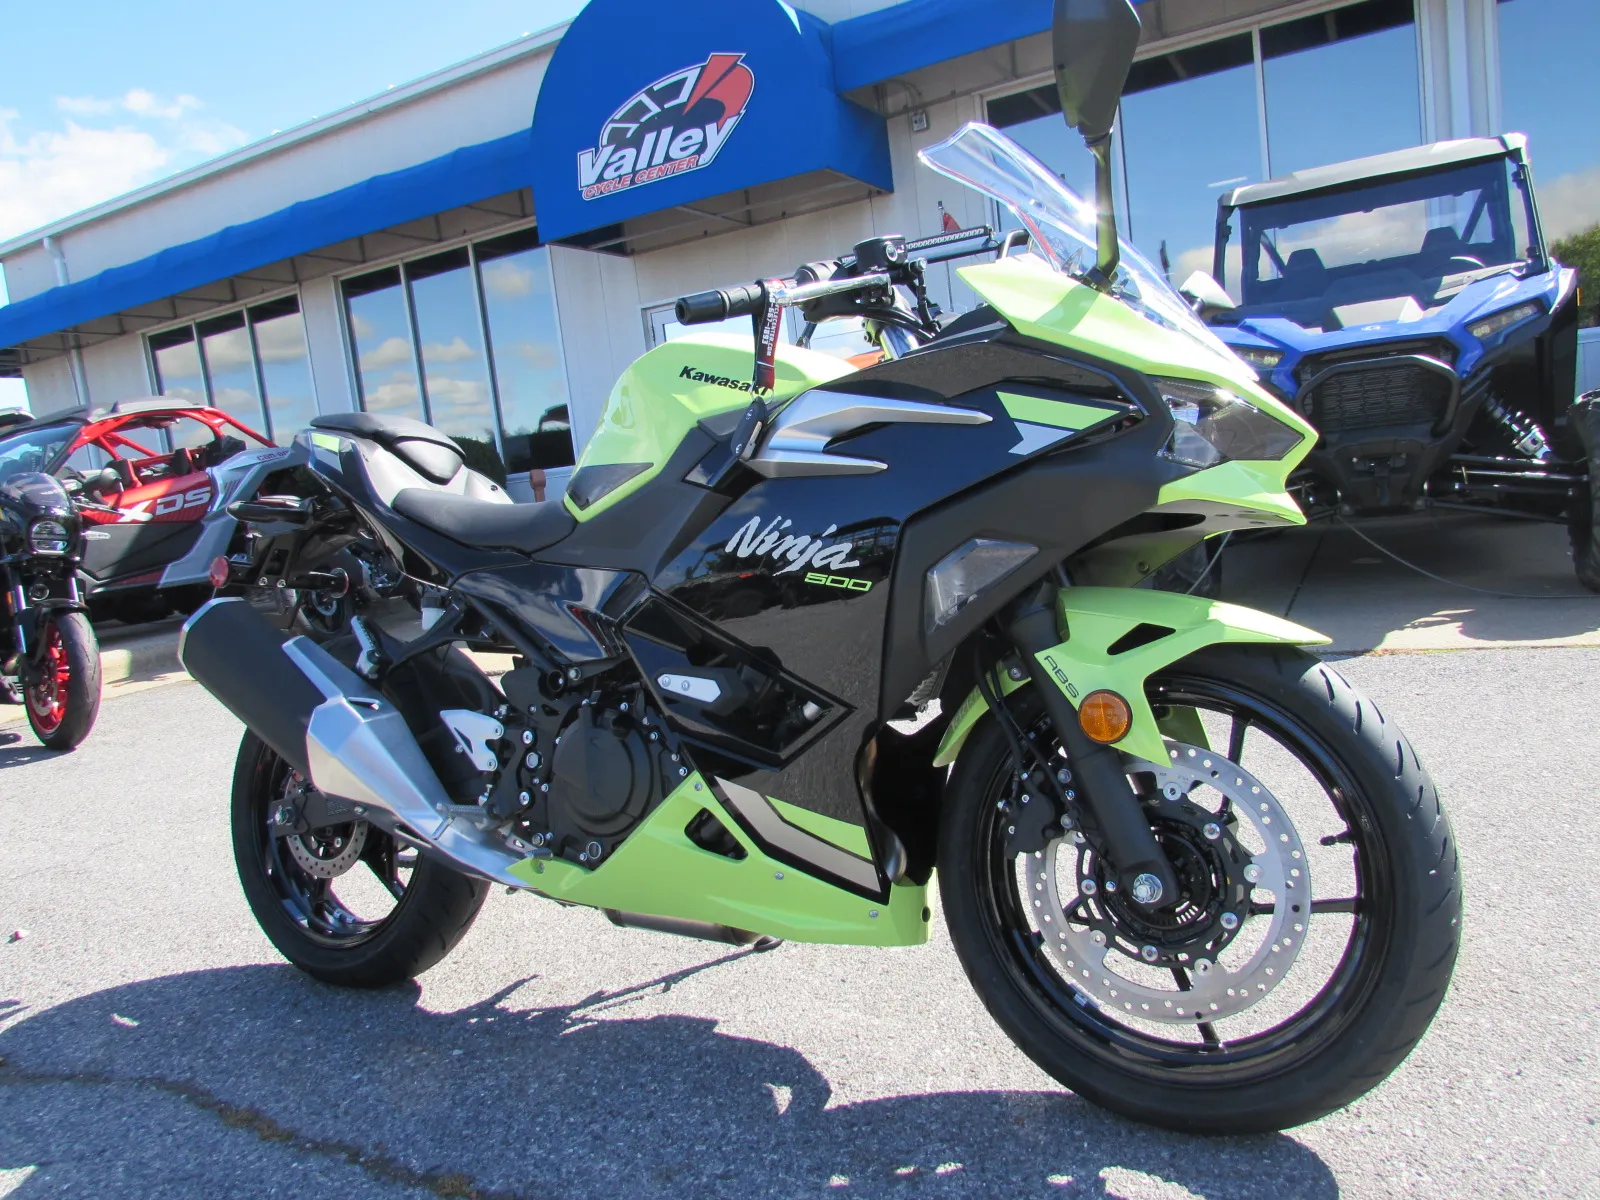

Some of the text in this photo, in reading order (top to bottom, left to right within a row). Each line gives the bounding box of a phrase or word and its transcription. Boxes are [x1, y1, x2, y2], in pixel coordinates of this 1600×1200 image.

[579, 114, 741, 188] Valley
[583, 154, 699, 199] CYCLE CENTER
[761, 287, 776, 345] 40-667-1893
[116, 486, 212, 523] XDS
[725, 515, 860, 577] Ninja
[804, 572, 873, 592] 500
[1043, 655, 1080, 699] ABS
